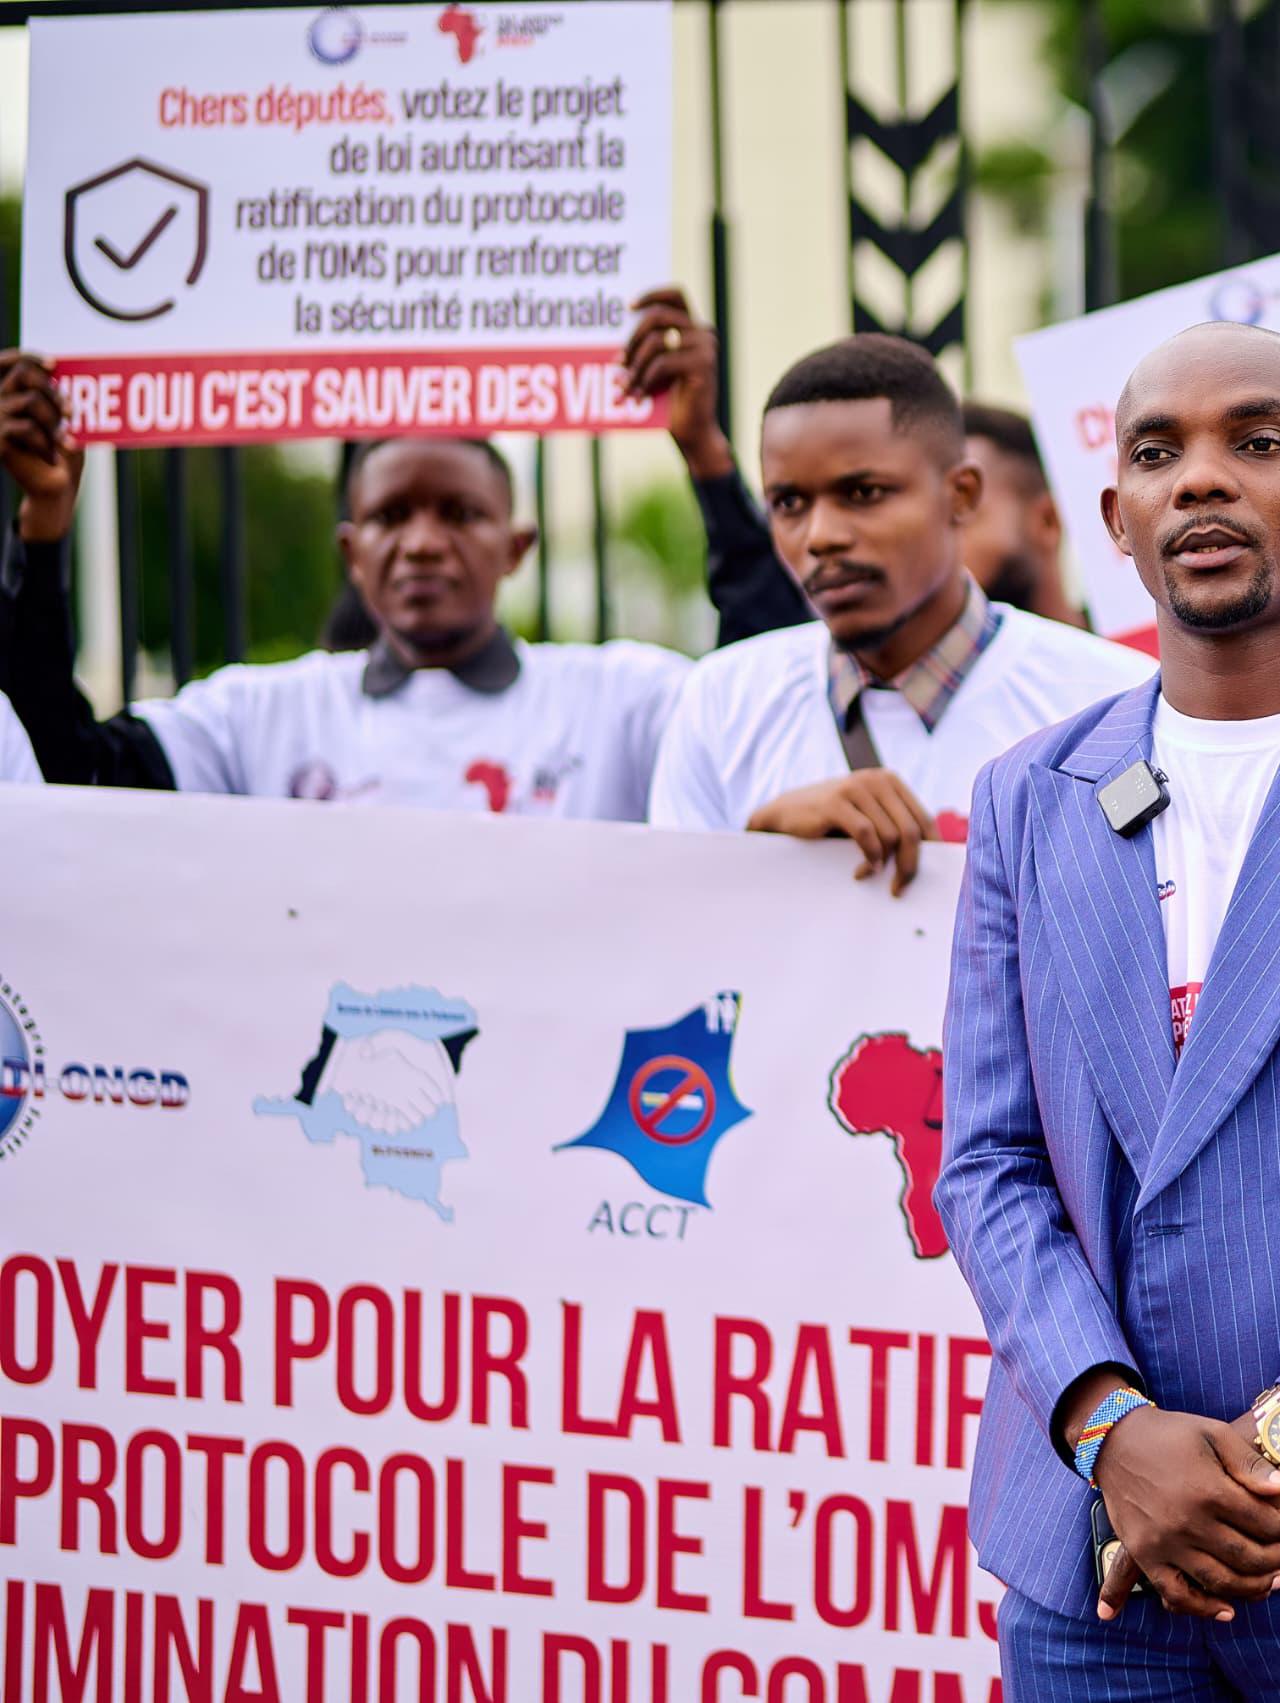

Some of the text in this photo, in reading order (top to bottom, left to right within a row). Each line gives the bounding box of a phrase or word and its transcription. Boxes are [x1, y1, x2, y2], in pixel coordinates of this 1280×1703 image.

[158, 75, 625, 132] Chers députés, votez le projet
[330, 129, 625, 174] de loi autorisant la
[235, 182, 626, 232] ratification du protocole
[257, 236, 626, 287] de l'OMS pour renforcer
[294, 289, 624, 332] la sécurité nationale
[58, 373, 122, 433] RE
[127, 371, 194, 432] OUI
[201, 368, 311, 431] C'EST
[312, 365, 472, 428] SAUVER
[476, 363, 558, 425] DES
[587, 1199, 698, 1241] ACCT
[0, 1253, 993, 1470] OYER POUR LA RATIF
[0, 1414, 1000, 1642] PROTOCOLE DE L'OM
[5, 1579, 508, 1703] IMINATION
